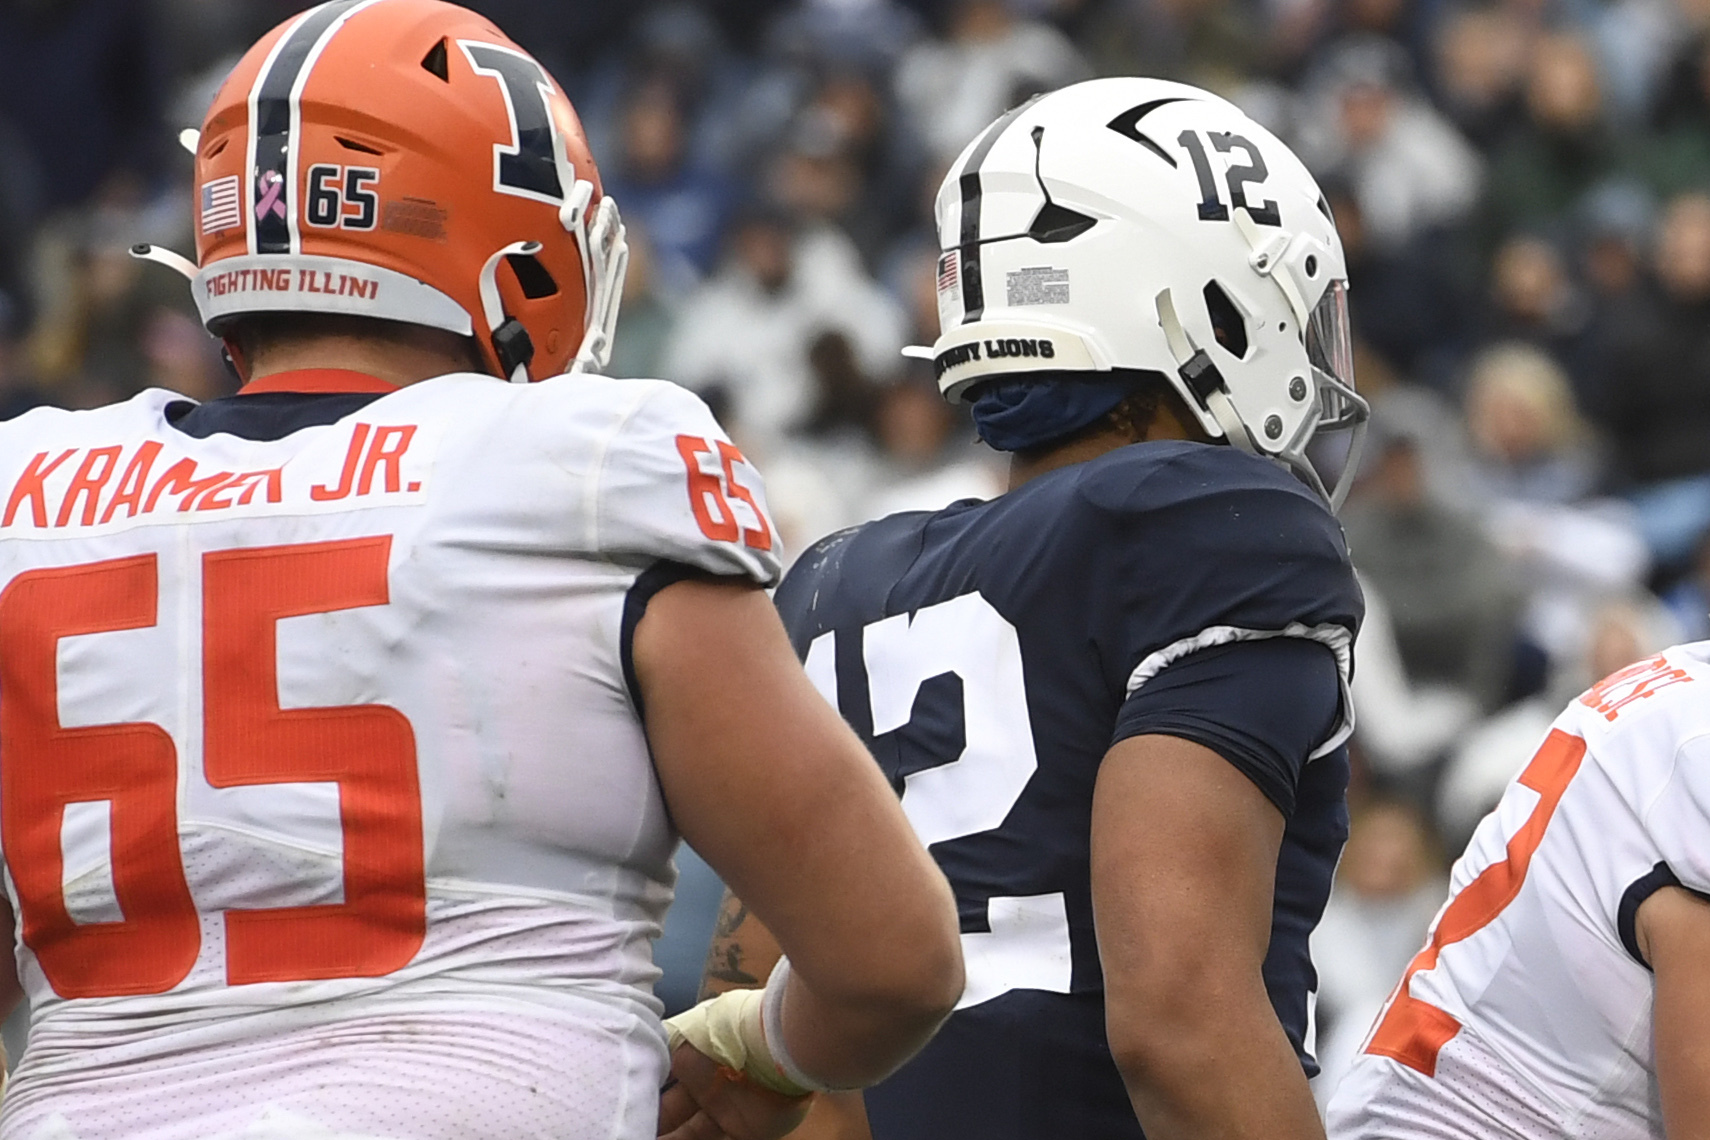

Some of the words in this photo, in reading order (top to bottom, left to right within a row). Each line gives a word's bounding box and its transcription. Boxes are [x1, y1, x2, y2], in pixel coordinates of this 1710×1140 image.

[306, 163, 380, 232] 65
[1177, 129, 1282, 228] 12
[206, 268, 292, 300] FIGHTING
[298, 268, 380, 300] ILLINI
[983, 338, 1055, 359] LIONS
[310, 422, 422, 502] JR.
[675, 434, 771, 551] 65
[0, 534, 427, 999] 65
